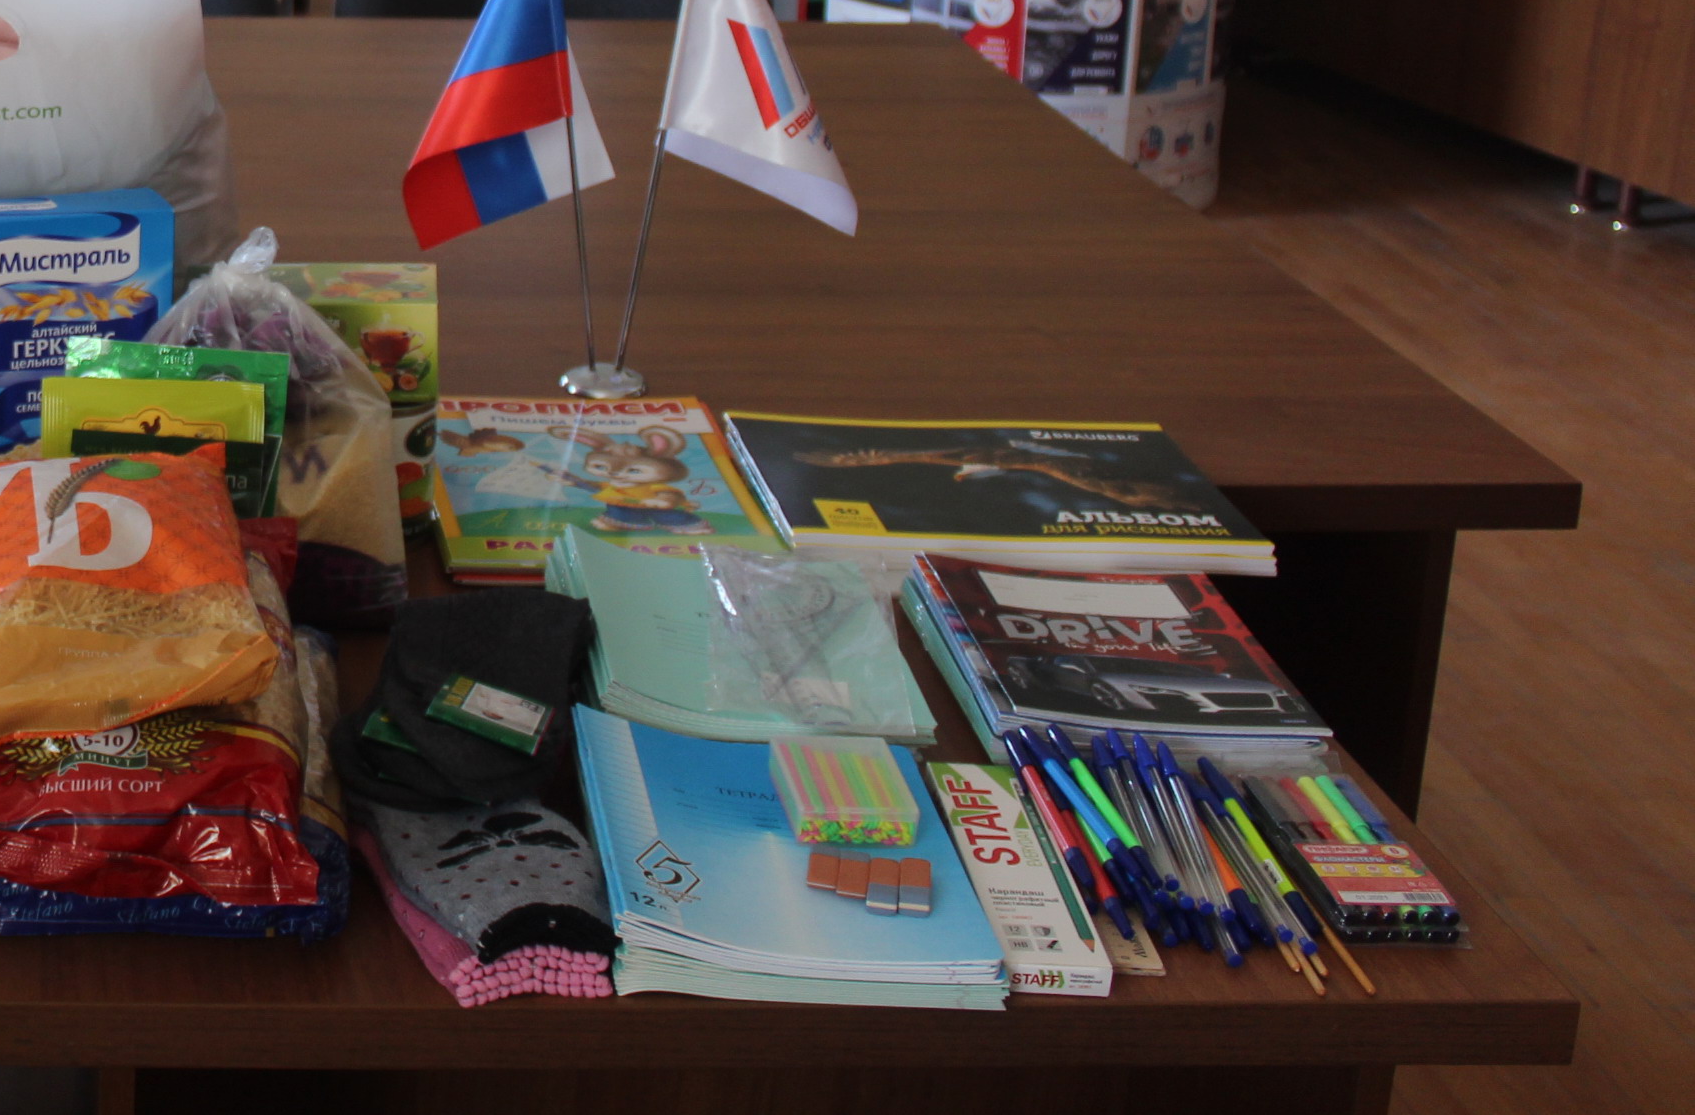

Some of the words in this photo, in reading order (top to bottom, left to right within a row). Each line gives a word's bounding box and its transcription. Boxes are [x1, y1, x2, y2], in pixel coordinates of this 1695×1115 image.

[31, 322, 97, 338] алтайский
[1052, 431, 1140, 442] BRAUBERG
[1056, 510, 1223, 528] АЛЬБОМ
[1042, 523, 1088, 536] для
[1093, 524, 1232, 538] рисования
[83, 734, 124, 747] 5-10
[73, 751, 132, 767] МИНУТ
[118, 778, 164, 794] СОРТ
[946, 778, 1021, 866] STAFF
[629, 890, 657, 910] 12
[9, 902, 74, 923] Stefano
[1011, 973, 1061, 986] STAFF
